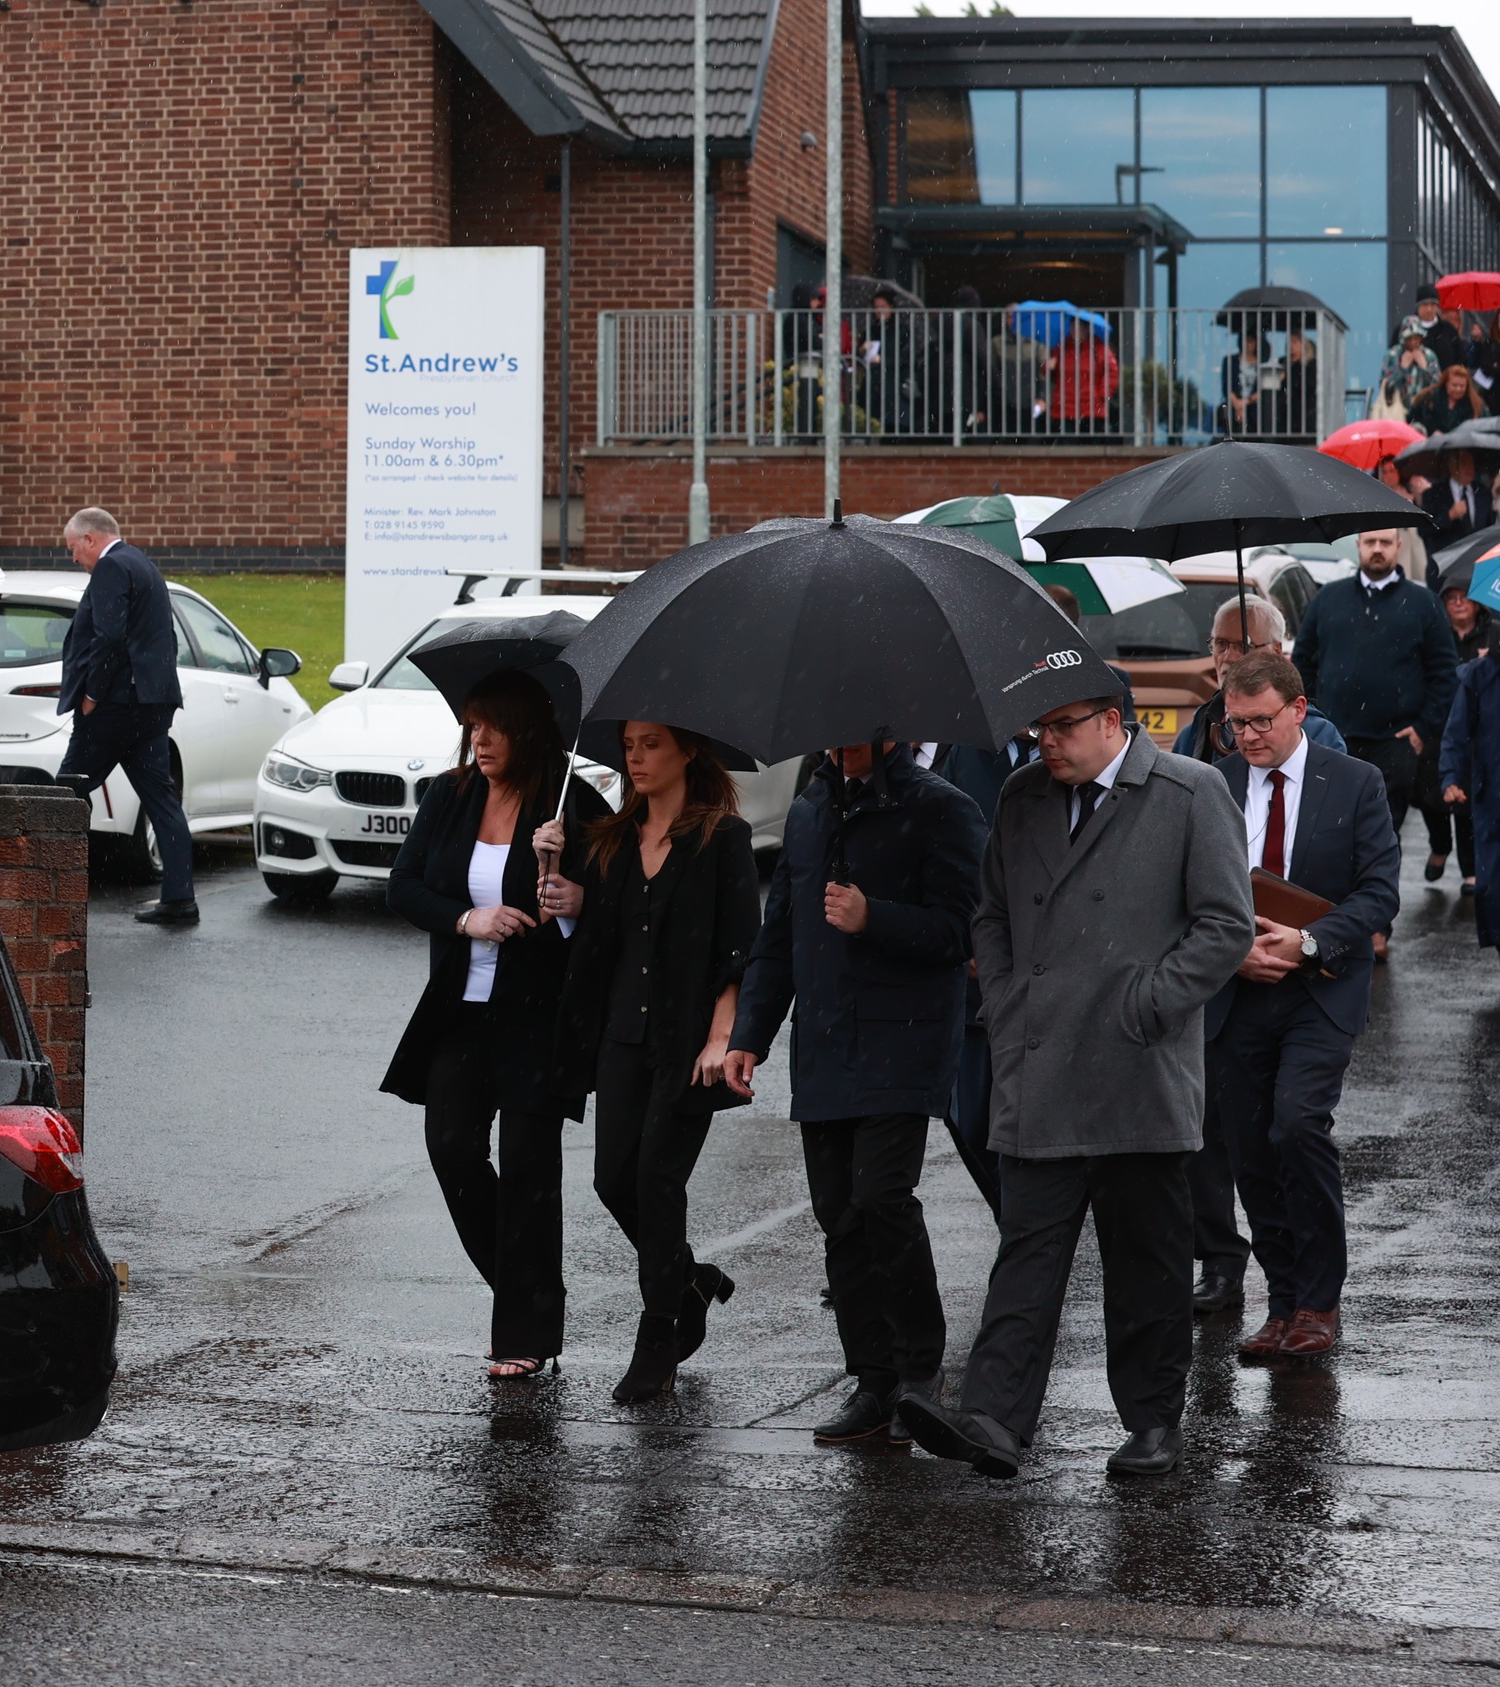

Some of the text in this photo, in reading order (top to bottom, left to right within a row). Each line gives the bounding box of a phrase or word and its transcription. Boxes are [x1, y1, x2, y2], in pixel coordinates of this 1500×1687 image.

[365, 353, 518, 373] St.Andrew's
[482, 373, 517, 382] Church
[365, 402, 476, 418] Welcomes you!
[365, 437, 476, 452] Sunday Worship
[364, 454, 425, 467] 11.00am
[429, 454, 440, 467] &
[428, 508, 452, 516] Mark
[455, 508, 497, 516] Johnston
[373, 521, 392, 529] 028
[394, 521, 418, 529] 9145
[421, 521, 445, 529] 9590
